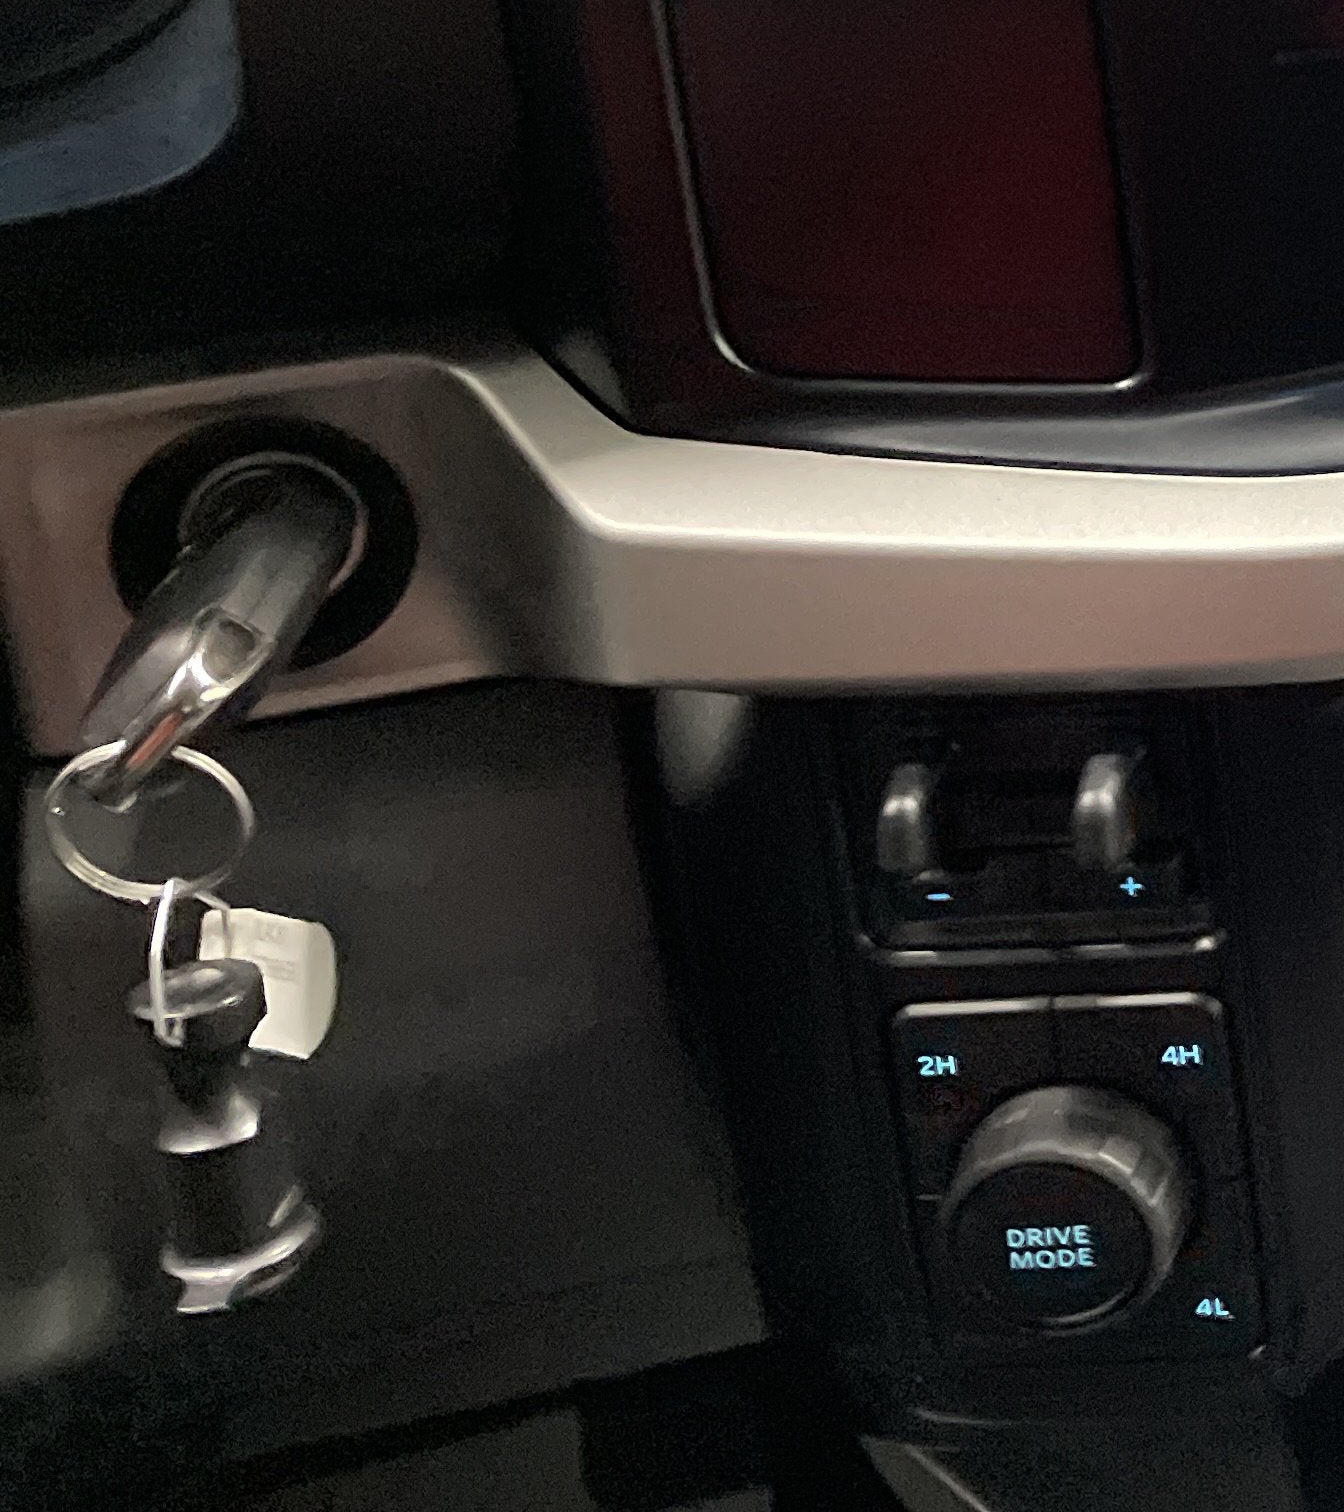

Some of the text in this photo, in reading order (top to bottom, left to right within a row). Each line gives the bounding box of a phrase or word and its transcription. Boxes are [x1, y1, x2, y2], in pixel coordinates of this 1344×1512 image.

[918, 1056, 957, 1076] 2H
[1162, 1045, 1200, 1066] 4H
[1006, 1225, 1091, 1247] DRIVE
[1009, 1247, 1094, 1269] MODE
[1196, 1298, 1229, 1315] 4L
